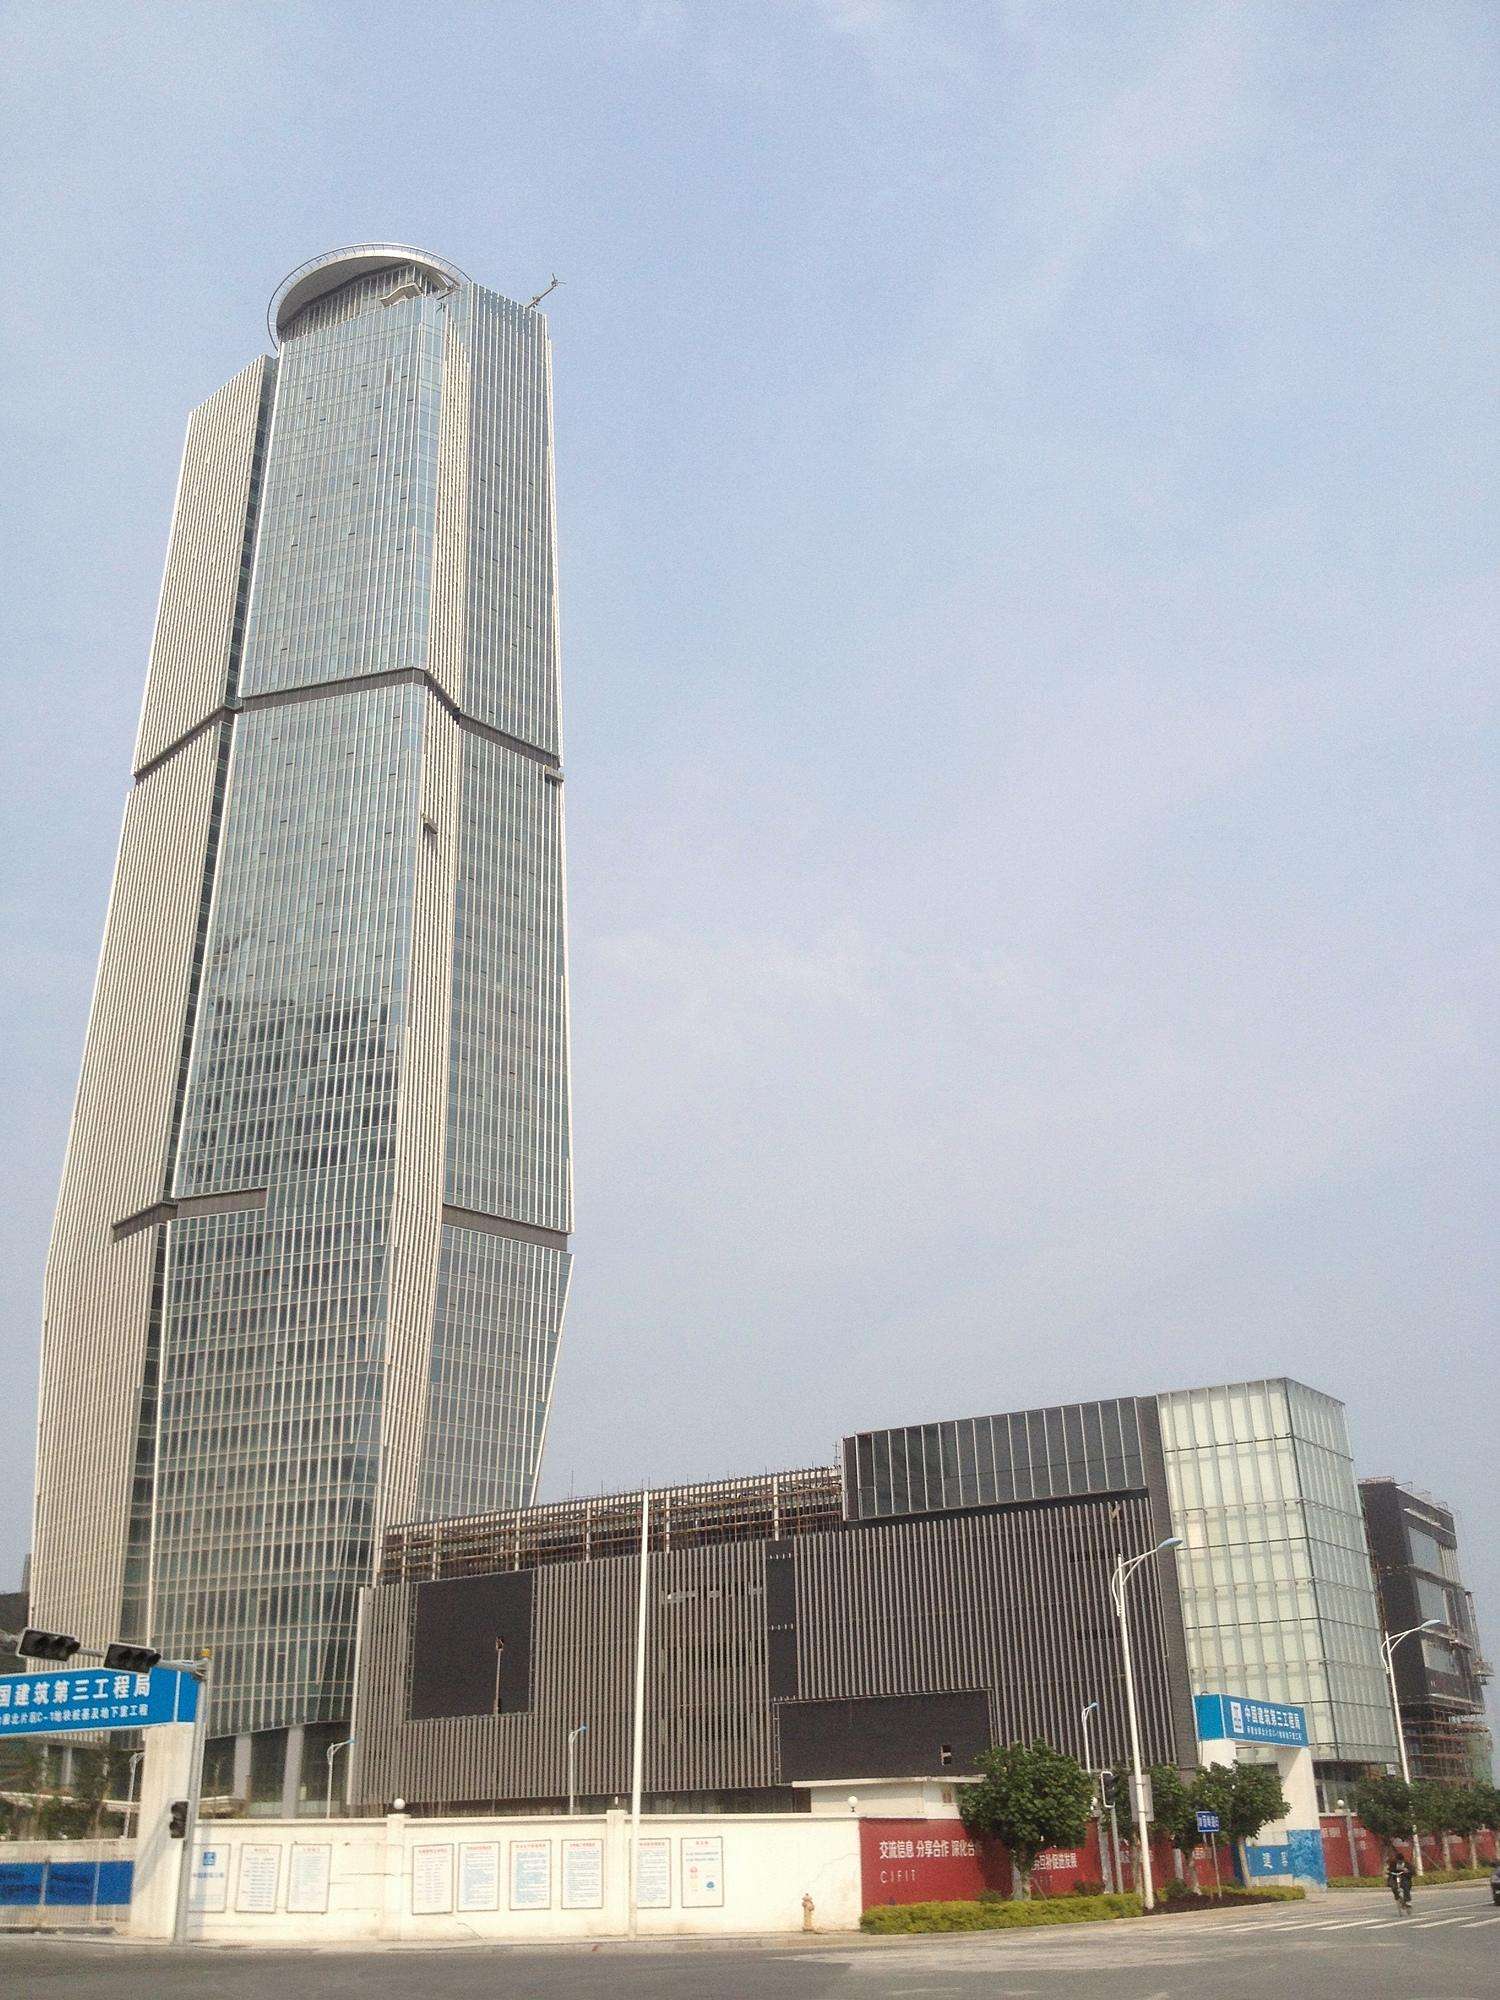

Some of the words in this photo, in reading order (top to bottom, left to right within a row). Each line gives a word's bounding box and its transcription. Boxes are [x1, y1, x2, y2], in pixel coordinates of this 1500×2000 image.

[1245, 1705, 1300, 1729] 中国建筑第三工程局
[880, 1840, 914, 1859] 交流信息
[916, 1840, 950, 1858] 分享合作
